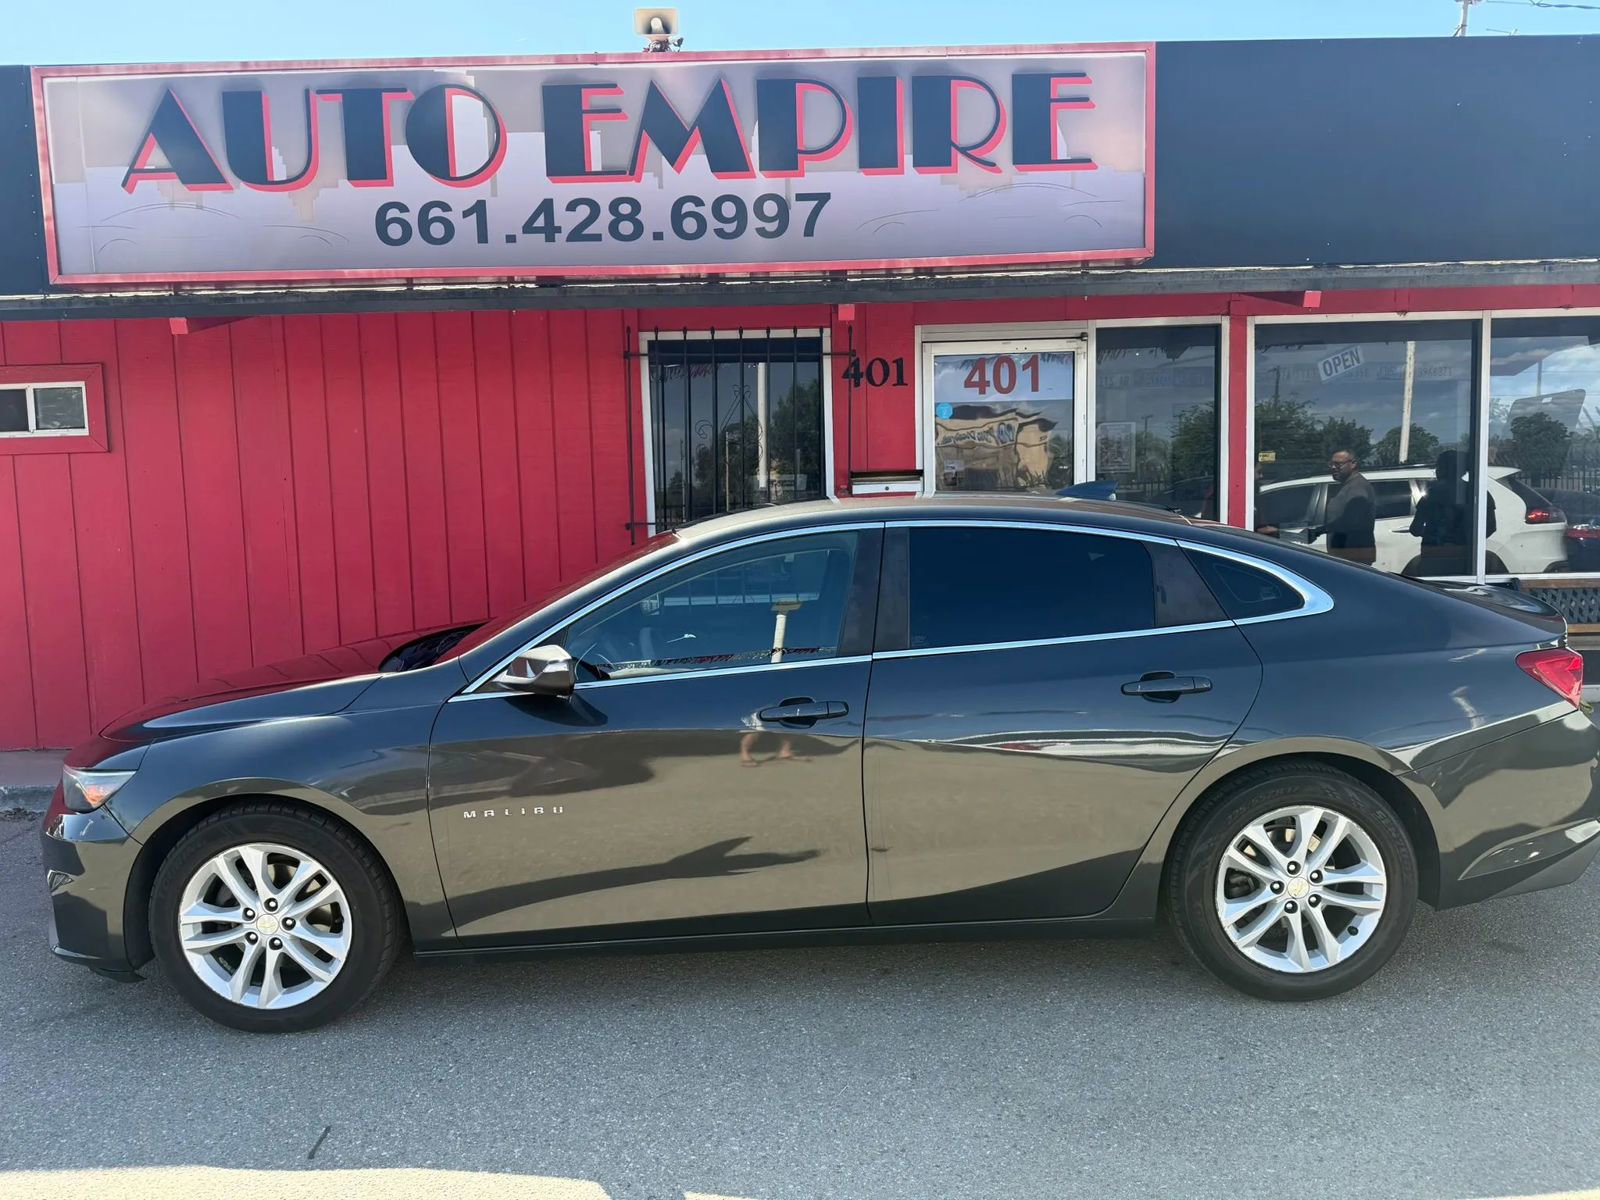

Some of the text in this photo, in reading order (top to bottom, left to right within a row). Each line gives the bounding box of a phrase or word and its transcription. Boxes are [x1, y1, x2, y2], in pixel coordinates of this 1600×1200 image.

[121, 71, 1098, 195] AUTO EMPIRE
[375, 191, 832, 247] 661.428.6997
[841, 356, 908, 388] 401
[963, 354, 1040, 395] 401
[1322, 349, 1361, 377] OPEN
[463, 806, 564, 819] MALIBU
